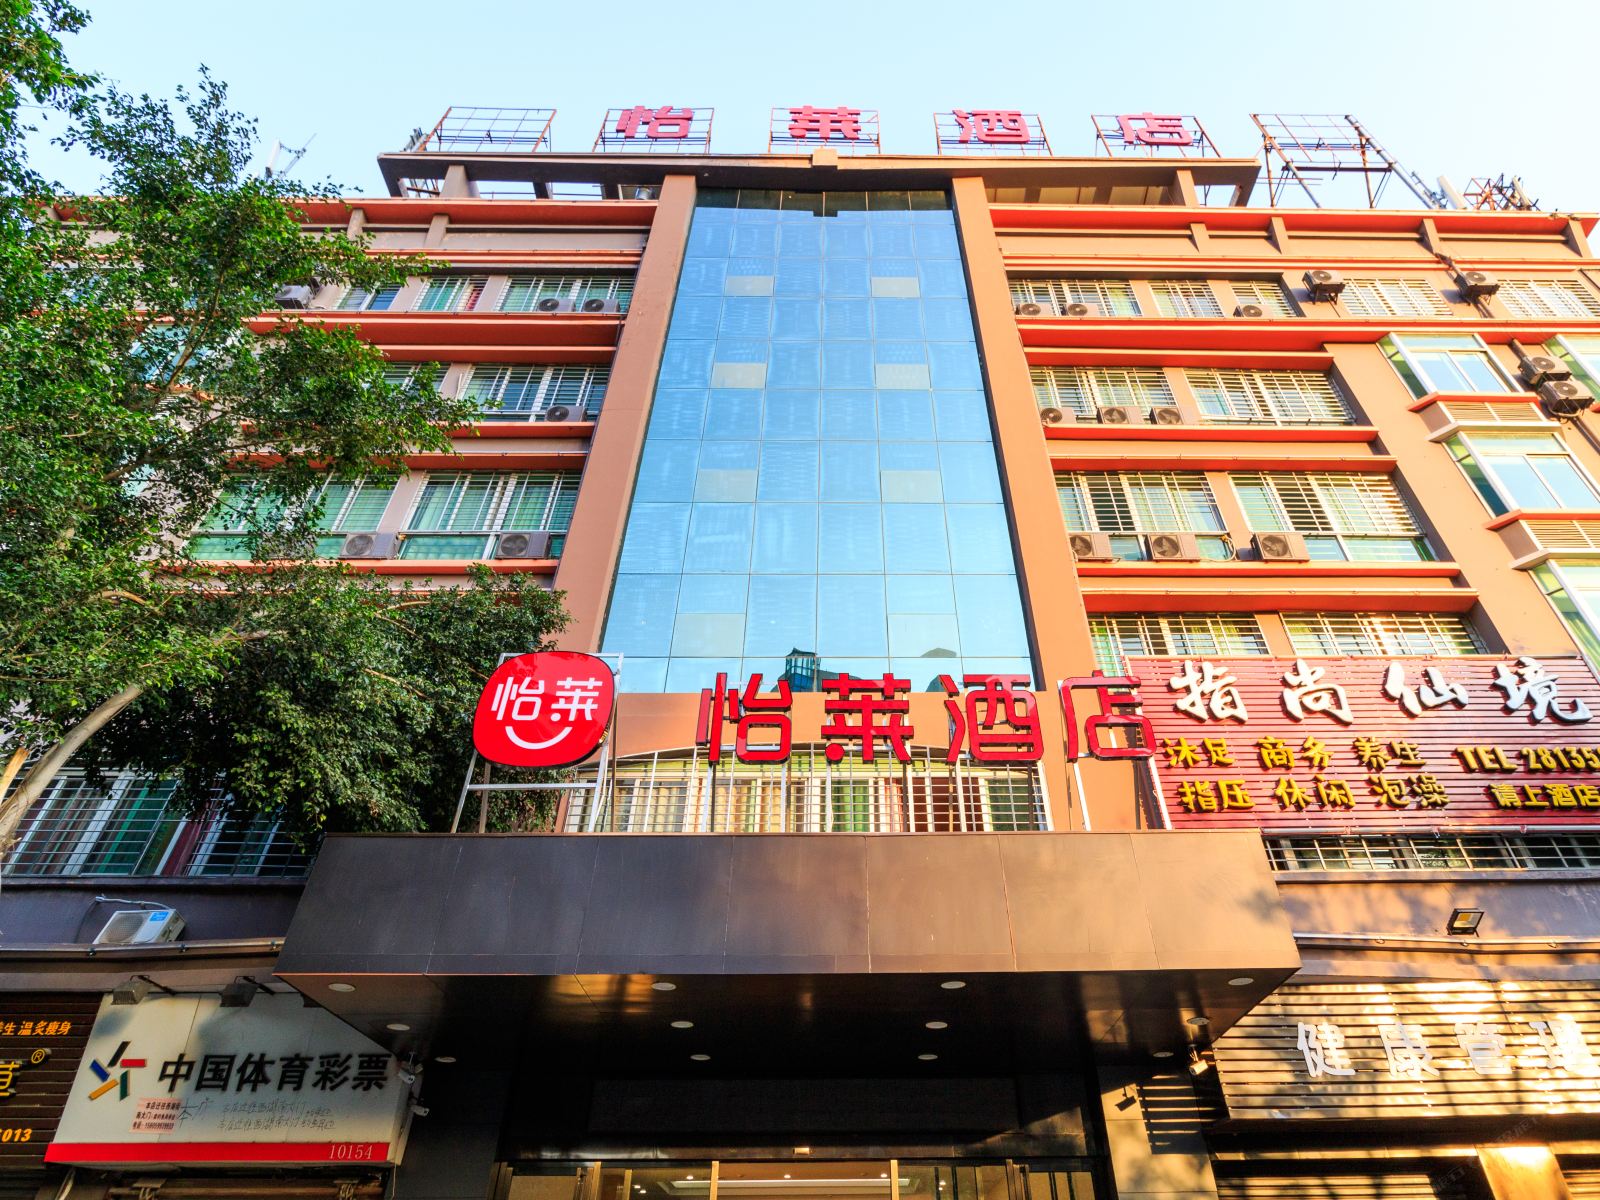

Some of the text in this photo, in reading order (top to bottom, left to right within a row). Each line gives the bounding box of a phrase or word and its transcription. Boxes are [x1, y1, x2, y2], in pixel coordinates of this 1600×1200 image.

[616, 105, 1193, 146] 怡莱酒店
[490, 675, 603, 722] 怡莱
[1169, 656, 1593, 724] 指尚仙境
[695, 670, 1157, 765] 怡莱酒店
[1163, 736, 1427, 770] 沐足 商务 养生
[1455, 746, 1600, 770] TEL 28135
[1178, 774, 1449, 813] 指压 休闲 泡澡
[158, 1052, 392, 1094] 中国体育彩票
[0, 1128, 32, 1143] 013
[328, 1144, 373, 1160] 10154
